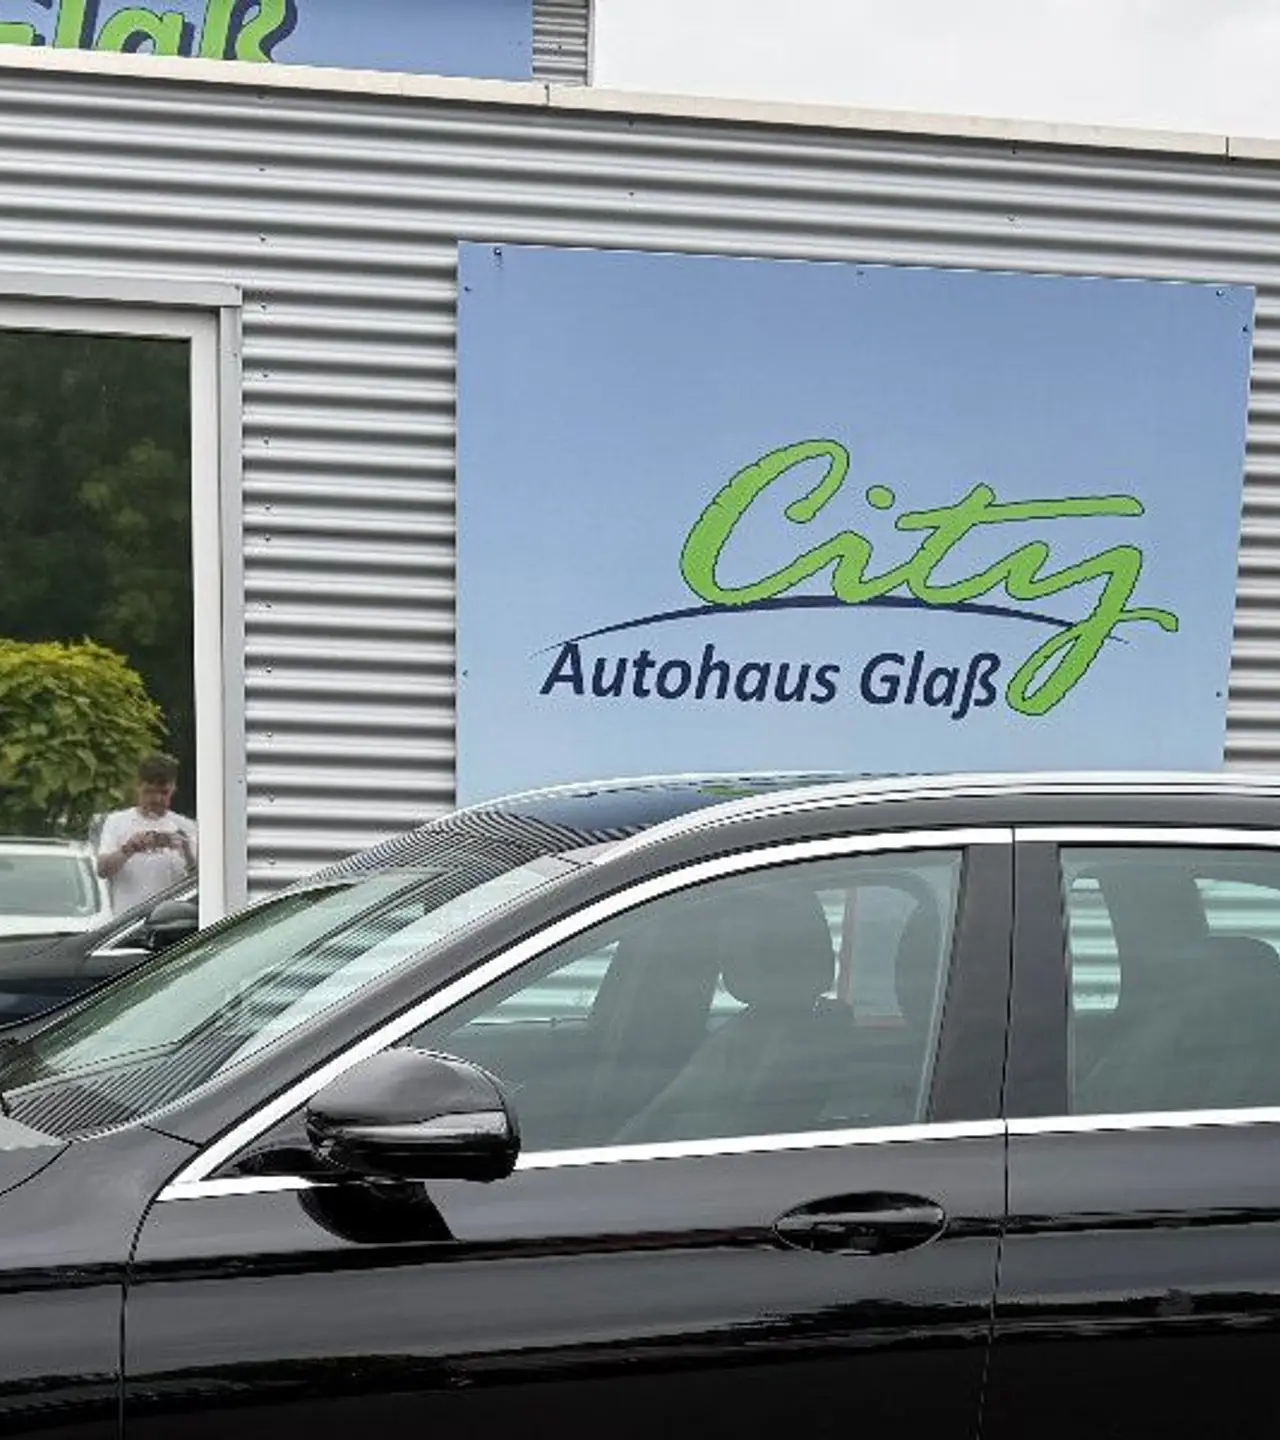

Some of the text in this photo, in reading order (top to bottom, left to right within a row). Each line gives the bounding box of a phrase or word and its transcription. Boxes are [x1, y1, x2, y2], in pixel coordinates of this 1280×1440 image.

[680, 438, 1179, 717] City
[540, 641, 1002, 721] Autohaus Glaß
